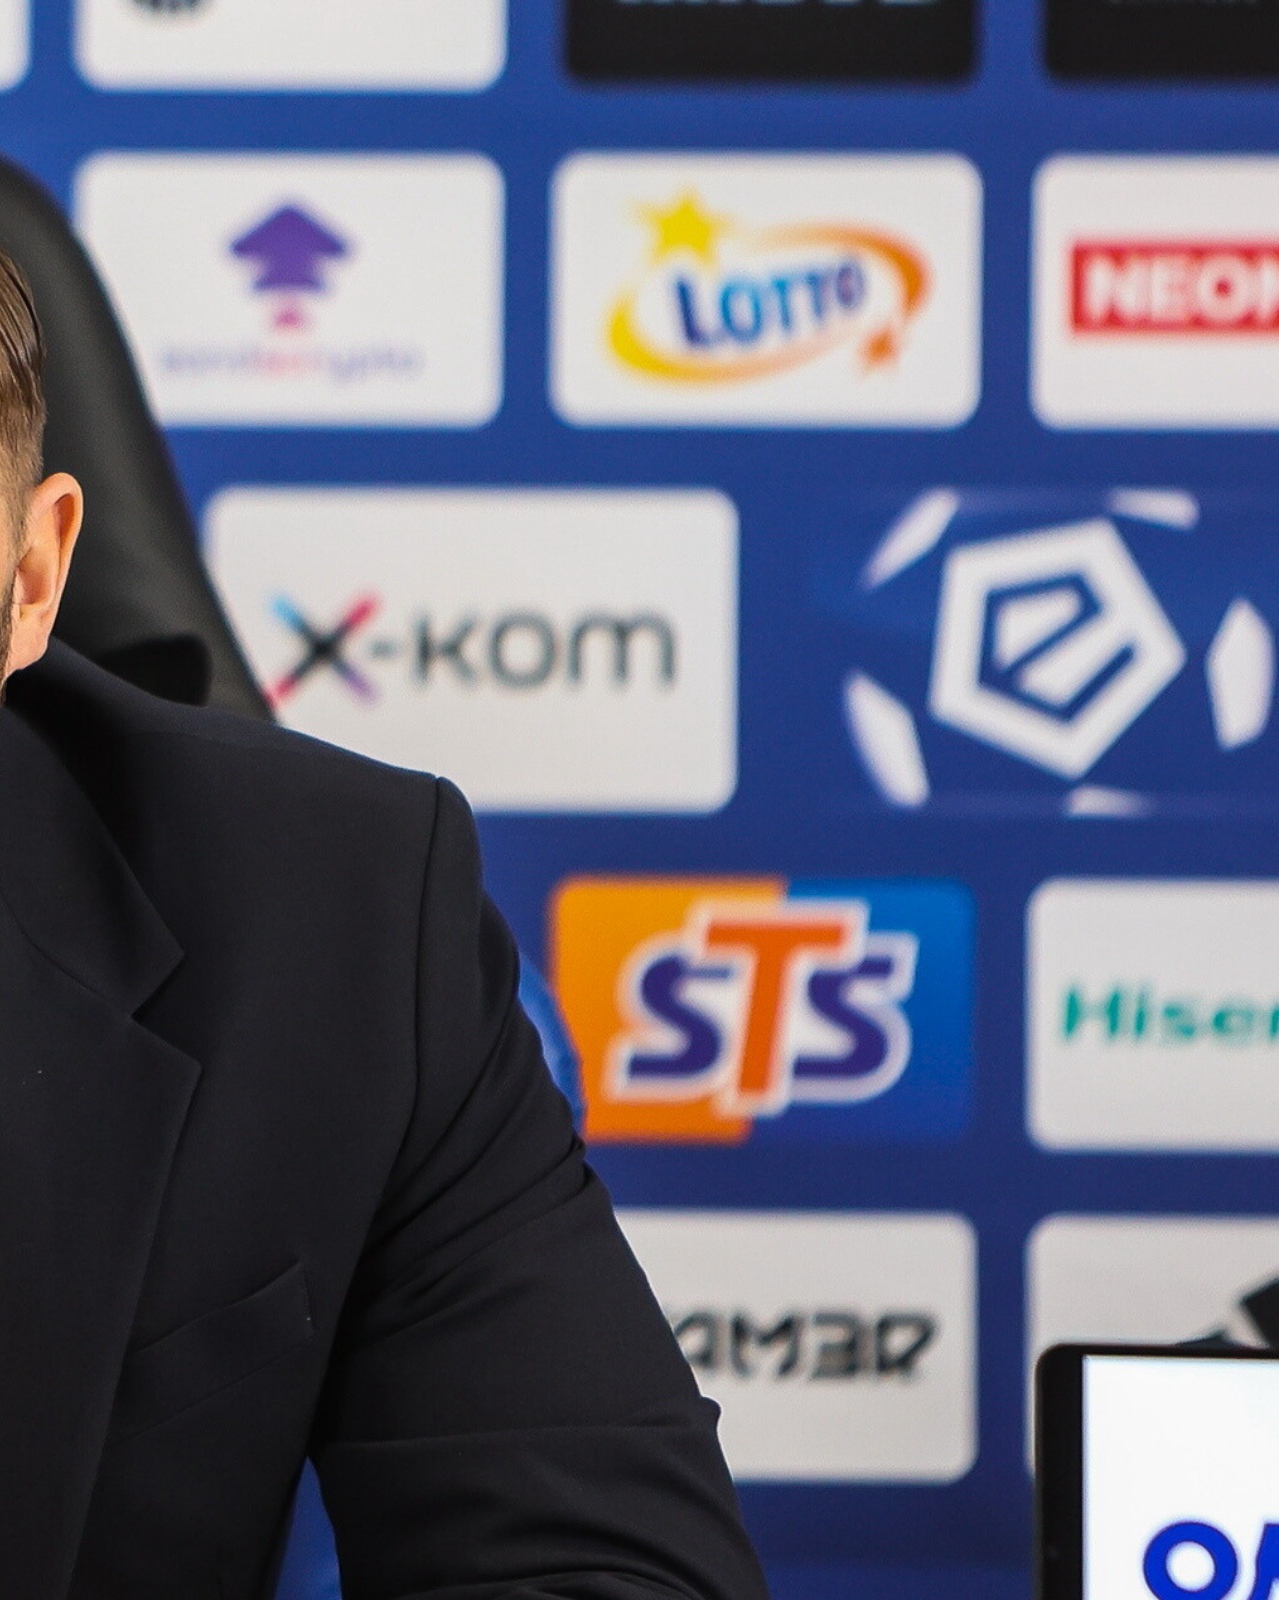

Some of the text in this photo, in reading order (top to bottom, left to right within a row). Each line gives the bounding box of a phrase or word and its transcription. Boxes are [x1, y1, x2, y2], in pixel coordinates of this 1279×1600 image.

[674, 262, 867, 350] LOTTO
[615, 904, 907, 1114] STS
[1063, 982, 1279, 1042] Hise
